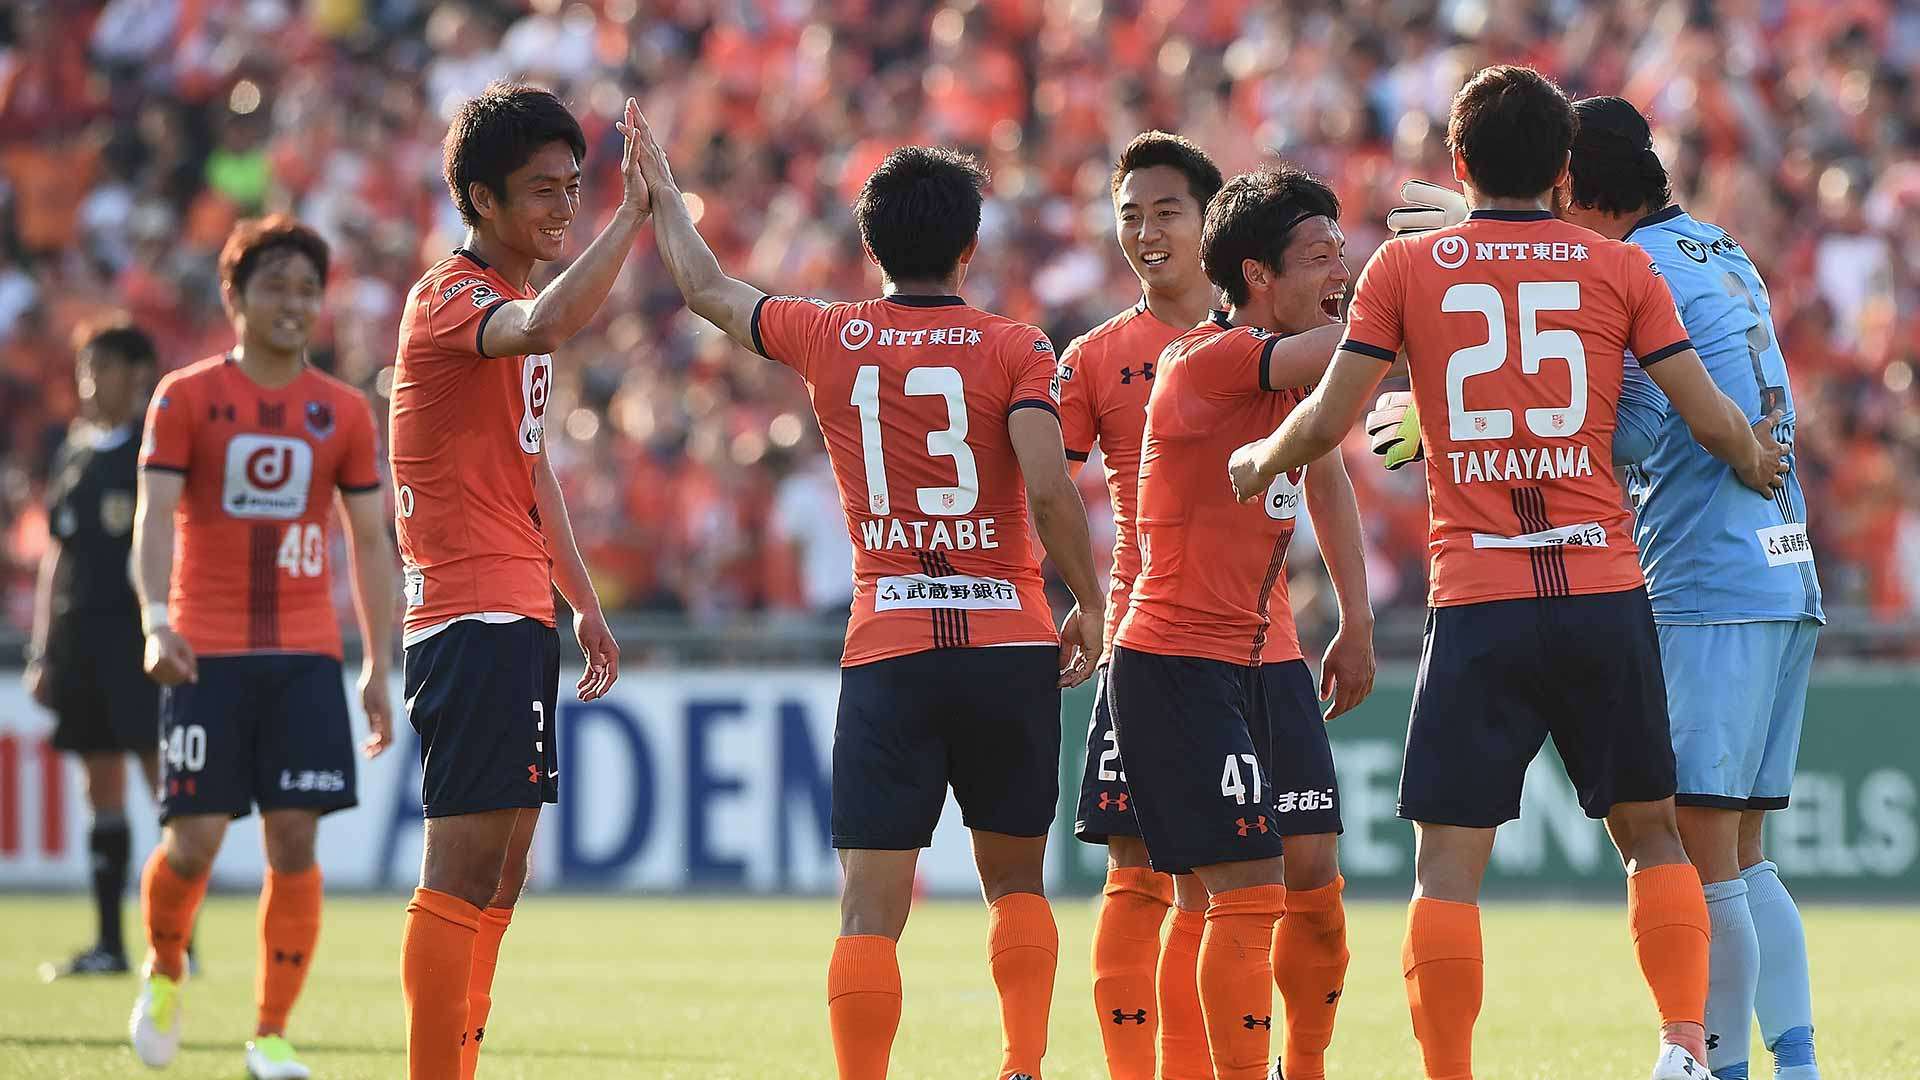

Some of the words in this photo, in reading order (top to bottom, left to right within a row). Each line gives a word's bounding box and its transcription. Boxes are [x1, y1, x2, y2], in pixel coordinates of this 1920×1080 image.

[1440, 281, 1589, 441] 25
[850, 365, 979, 516] 13
[1447, 445, 1593, 484] TAKAYAMA
[277, 523, 323, 577] 40
[860, 518, 999, 551] WATABE
[906, 582, 1013, 601] 武蔵野銀行
[168, 724, 207, 772] 40
[1098, 730, 1127, 782] 2
[1221, 754, 1261, 804] 47
[1273, 788, 1333, 813] まむら
